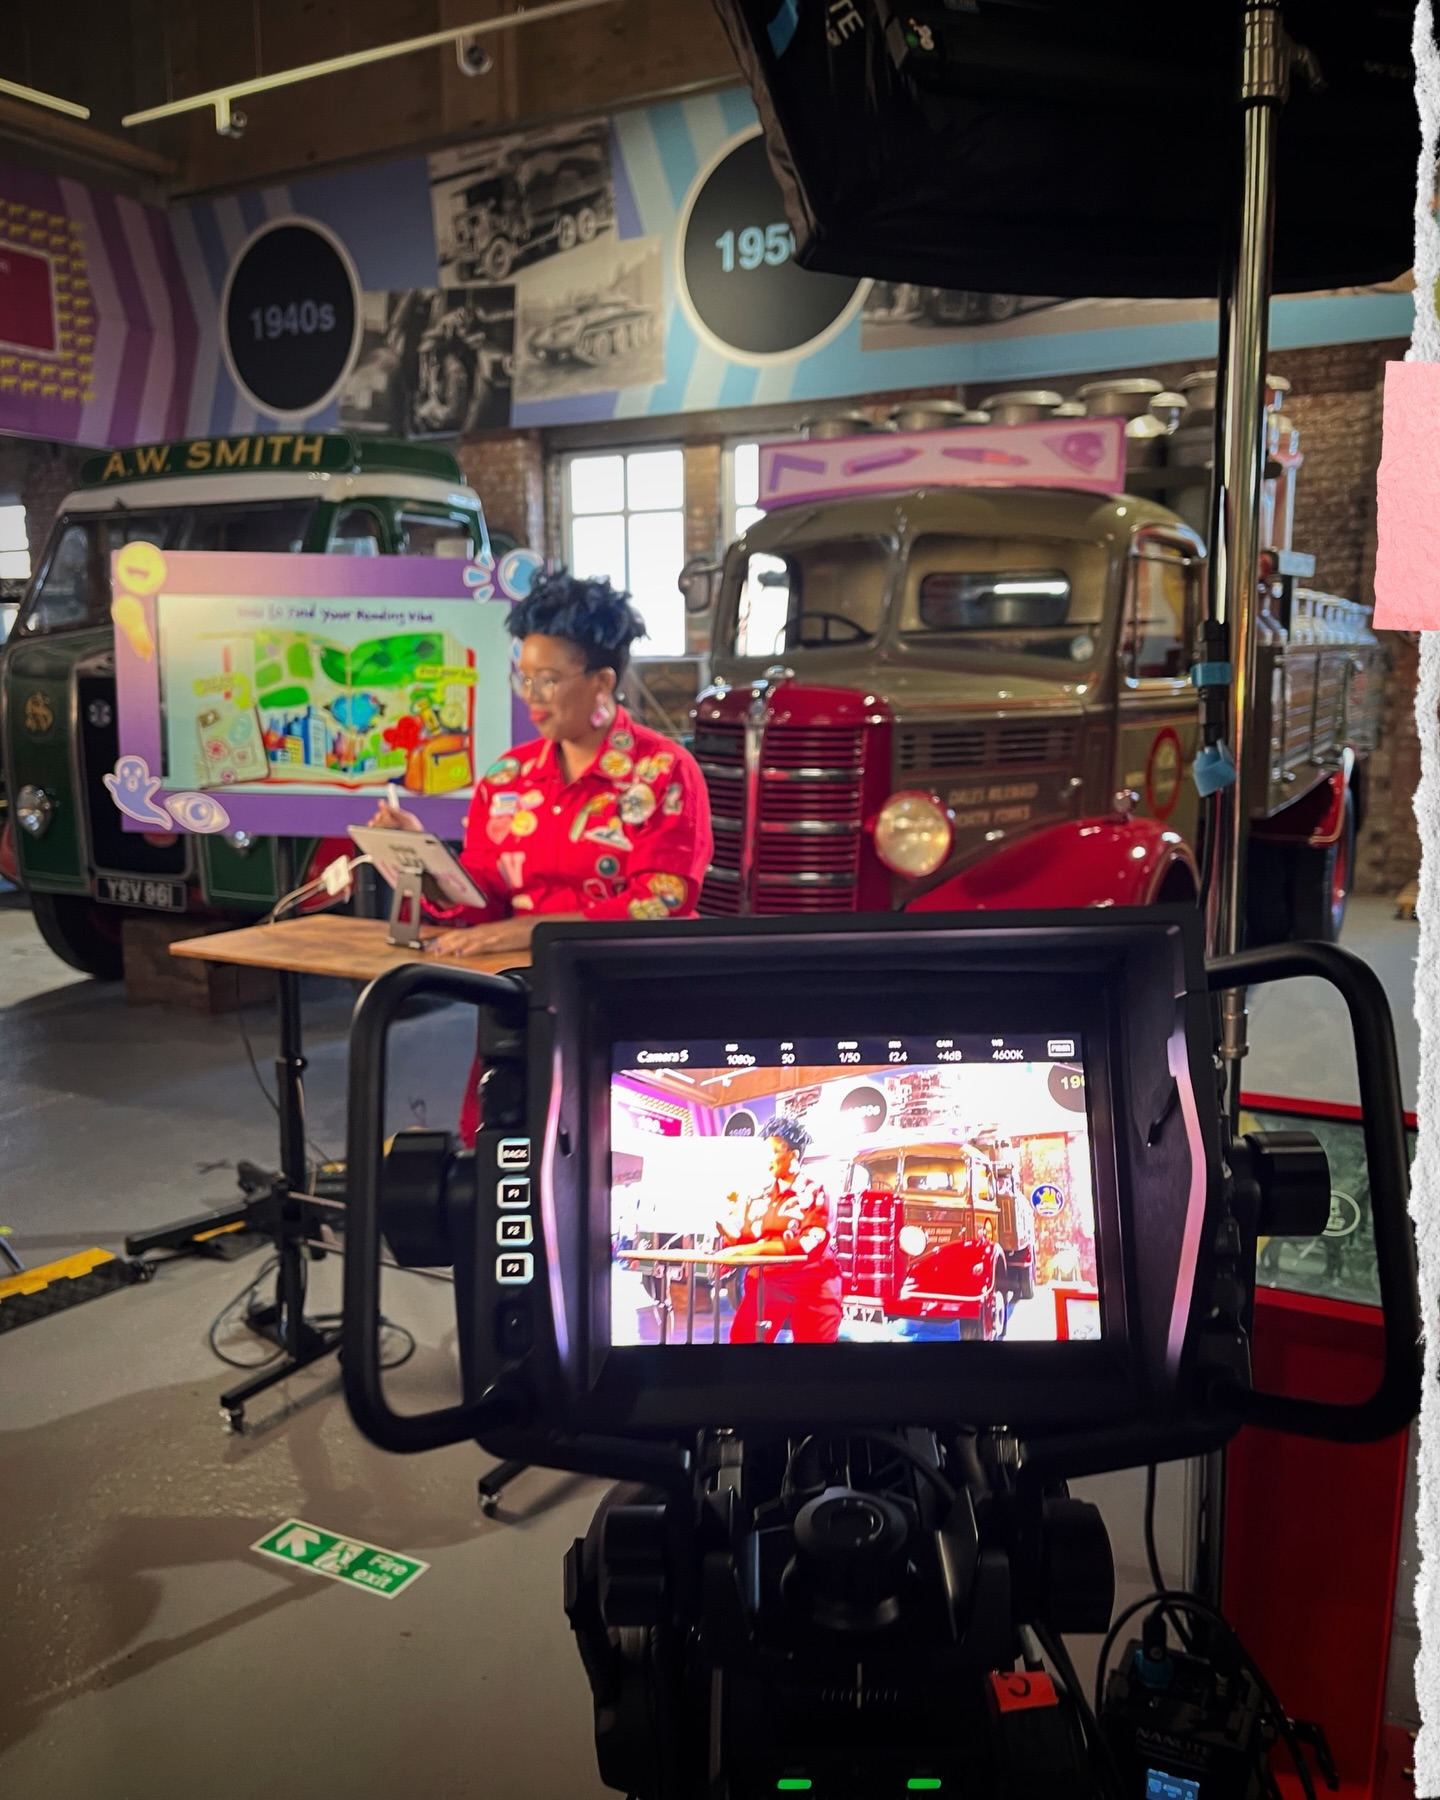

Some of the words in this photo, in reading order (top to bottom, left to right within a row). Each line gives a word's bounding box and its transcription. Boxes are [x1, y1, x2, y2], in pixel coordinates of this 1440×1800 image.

[249, 299, 336, 341] 1940s
[102, 446, 170, 480] A.W.
[185, 436, 324, 470] SMITH
[637, 1050, 679, 1063] Camera
[727, 1054, 756, 1066] 1080p
[781, 1053, 795, 1064] 50
[838, 1052, 861, 1063] 1/50
[937, 1051, 961, 1062] +4dB
[992, 1050, 1023, 1061] 4600K
[368, 1554, 408, 1576] Fire
[353, 1568, 393, 1589] exit
